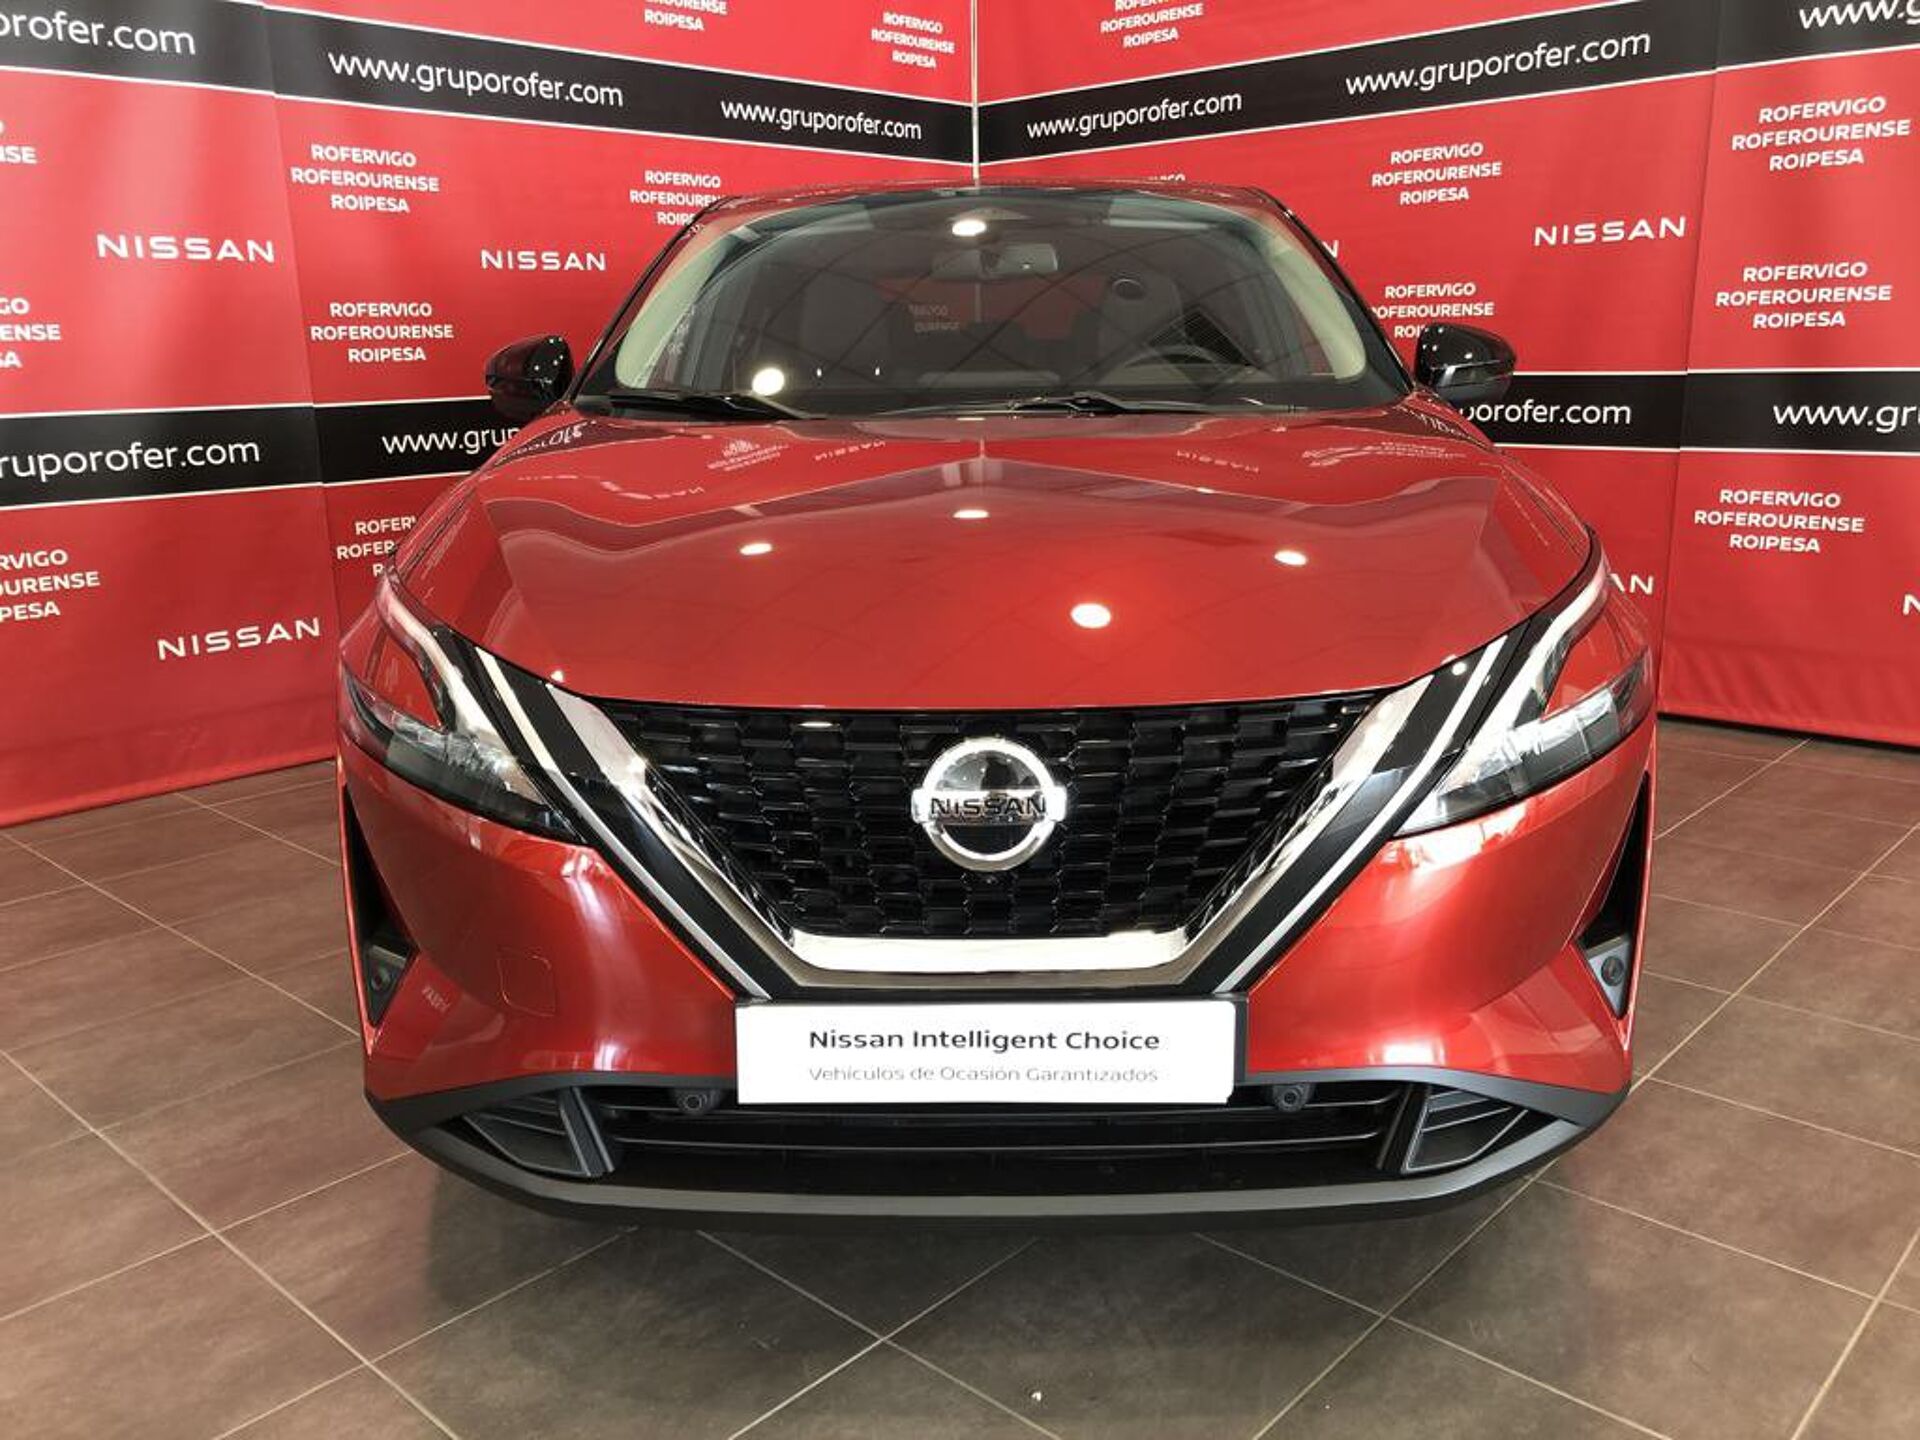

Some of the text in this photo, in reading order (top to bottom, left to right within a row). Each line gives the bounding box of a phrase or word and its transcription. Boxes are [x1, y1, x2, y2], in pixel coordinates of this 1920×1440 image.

[645, 9, 704, 30] ROIPESA
[883, 12, 943, 33] ROFERVIGO
[1101, 3, 1203, 32] ROFEROURENSE
[872, 29, 954, 53] ROFEROURENSE
[1124, 28, 1178, 47] ROIPESA
[893, 50, 936, 68] ROIPESA
[1346, 34, 1650, 94] www.gruporofer.com
[328, 53, 623, 106] www.gruporofer.com
[721, 101, 921, 139] www.gruporofer.com
[1027, 94, 1241, 138] www.gruporofer.com
[1759, 96, 1886, 123] ROFERVIGO
[1732, 120, 1910, 150] ROFEROURENSE
[311, 144, 416, 167] ROFERVIGO
[1391, 143, 1483, 164] ROFERVIGO
[1770, 148, 1864, 170] ROIPESA
[291, 167, 439, 191] ROFEROURENSE
[645, 171, 720, 188] ROFERVIGO
[1372, 162, 1502, 186] ROFEROURENSE
[331, 194, 409, 212] ROIPESA
[1400, 187, 1469, 204] ROIPESA
[1535, 217, 1685, 246] NISSAN
[97, 234, 274, 262] NISSAN
[481, 250, 605, 270] NISSAN
[1743, 262, 1867, 282] ROFERVIGO
[1385, 282, 1476, 298] ROFERVIGO
[1716, 285, 1892, 306] ROFEROURENSE
[330, 303, 432, 317] ROFERVIGO
[1753, 311, 1845, 328] ROIPESA
[311, 325, 453, 340] ROFEROURENSE
[349, 347, 426, 362] ROIPESA
[1773, 406, 1920, 433] www.gr
[1720, 490, 1840, 507] ROFERVIGO
[1695, 510, 1864, 532] ROFEROURENSE
[1730, 534, 1820, 552] ROIPESA
[0, 572, 100, 595] URENSE
[158, 618, 319, 659] NISSAN
[930, 798, 1047, 815] NISSAN
[810, 1030, 1159, 1053] Nissan Intelligent Choice
[910, 1067, 934, 1080] de
[940, 1066, 1020, 1080] Ocasión
[1025, 1068, 1158, 1082] Garantizados
